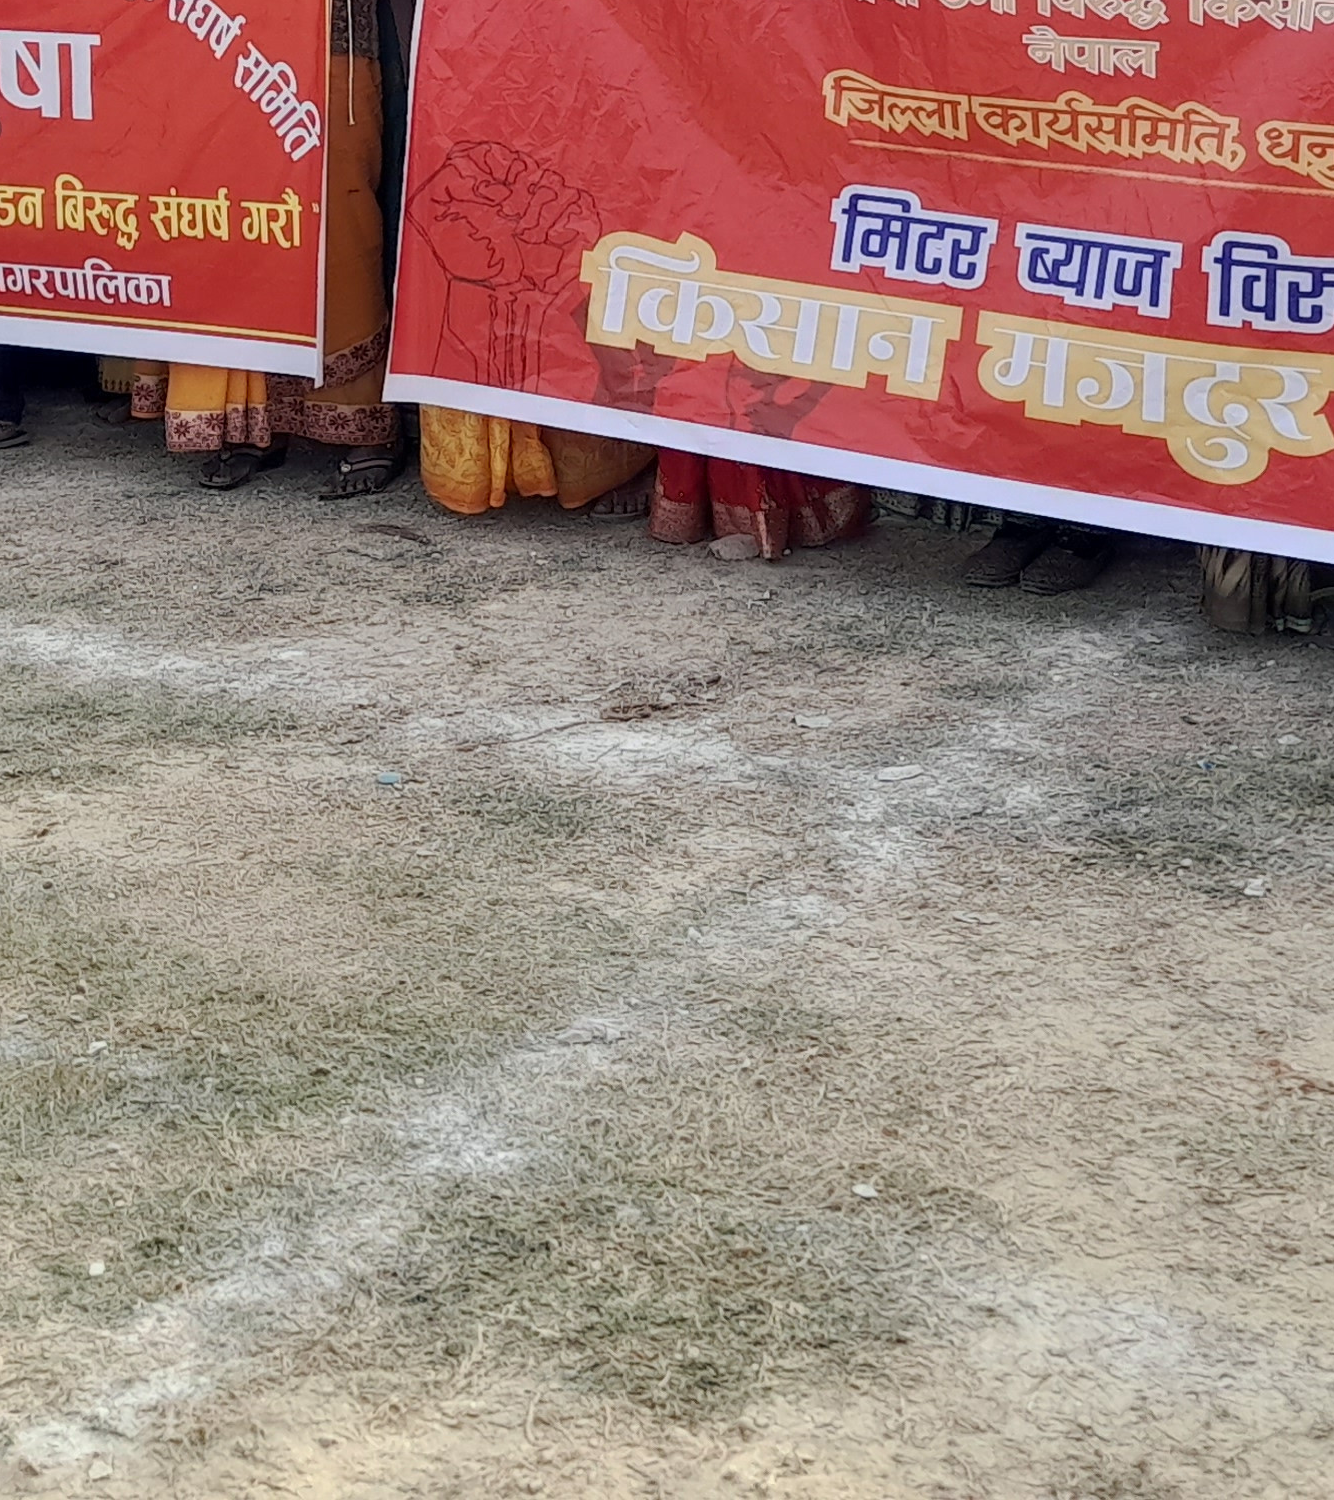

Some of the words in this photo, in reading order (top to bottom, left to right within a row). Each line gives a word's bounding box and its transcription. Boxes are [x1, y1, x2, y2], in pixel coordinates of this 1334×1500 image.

[1022, 25, 1160, 79] नेपाल
[233, 41, 322, 161] समिति
[823, 70, 968, 139] जिल्ला
[149, 187, 231, 241] संघर्ष
[834, 187, 994, 285] मिटर
[1019, 227, 1177, 316] ब्याज
[588, 238, 955, 393] किसान
[985, 318, 1333, 478] मजदुर
